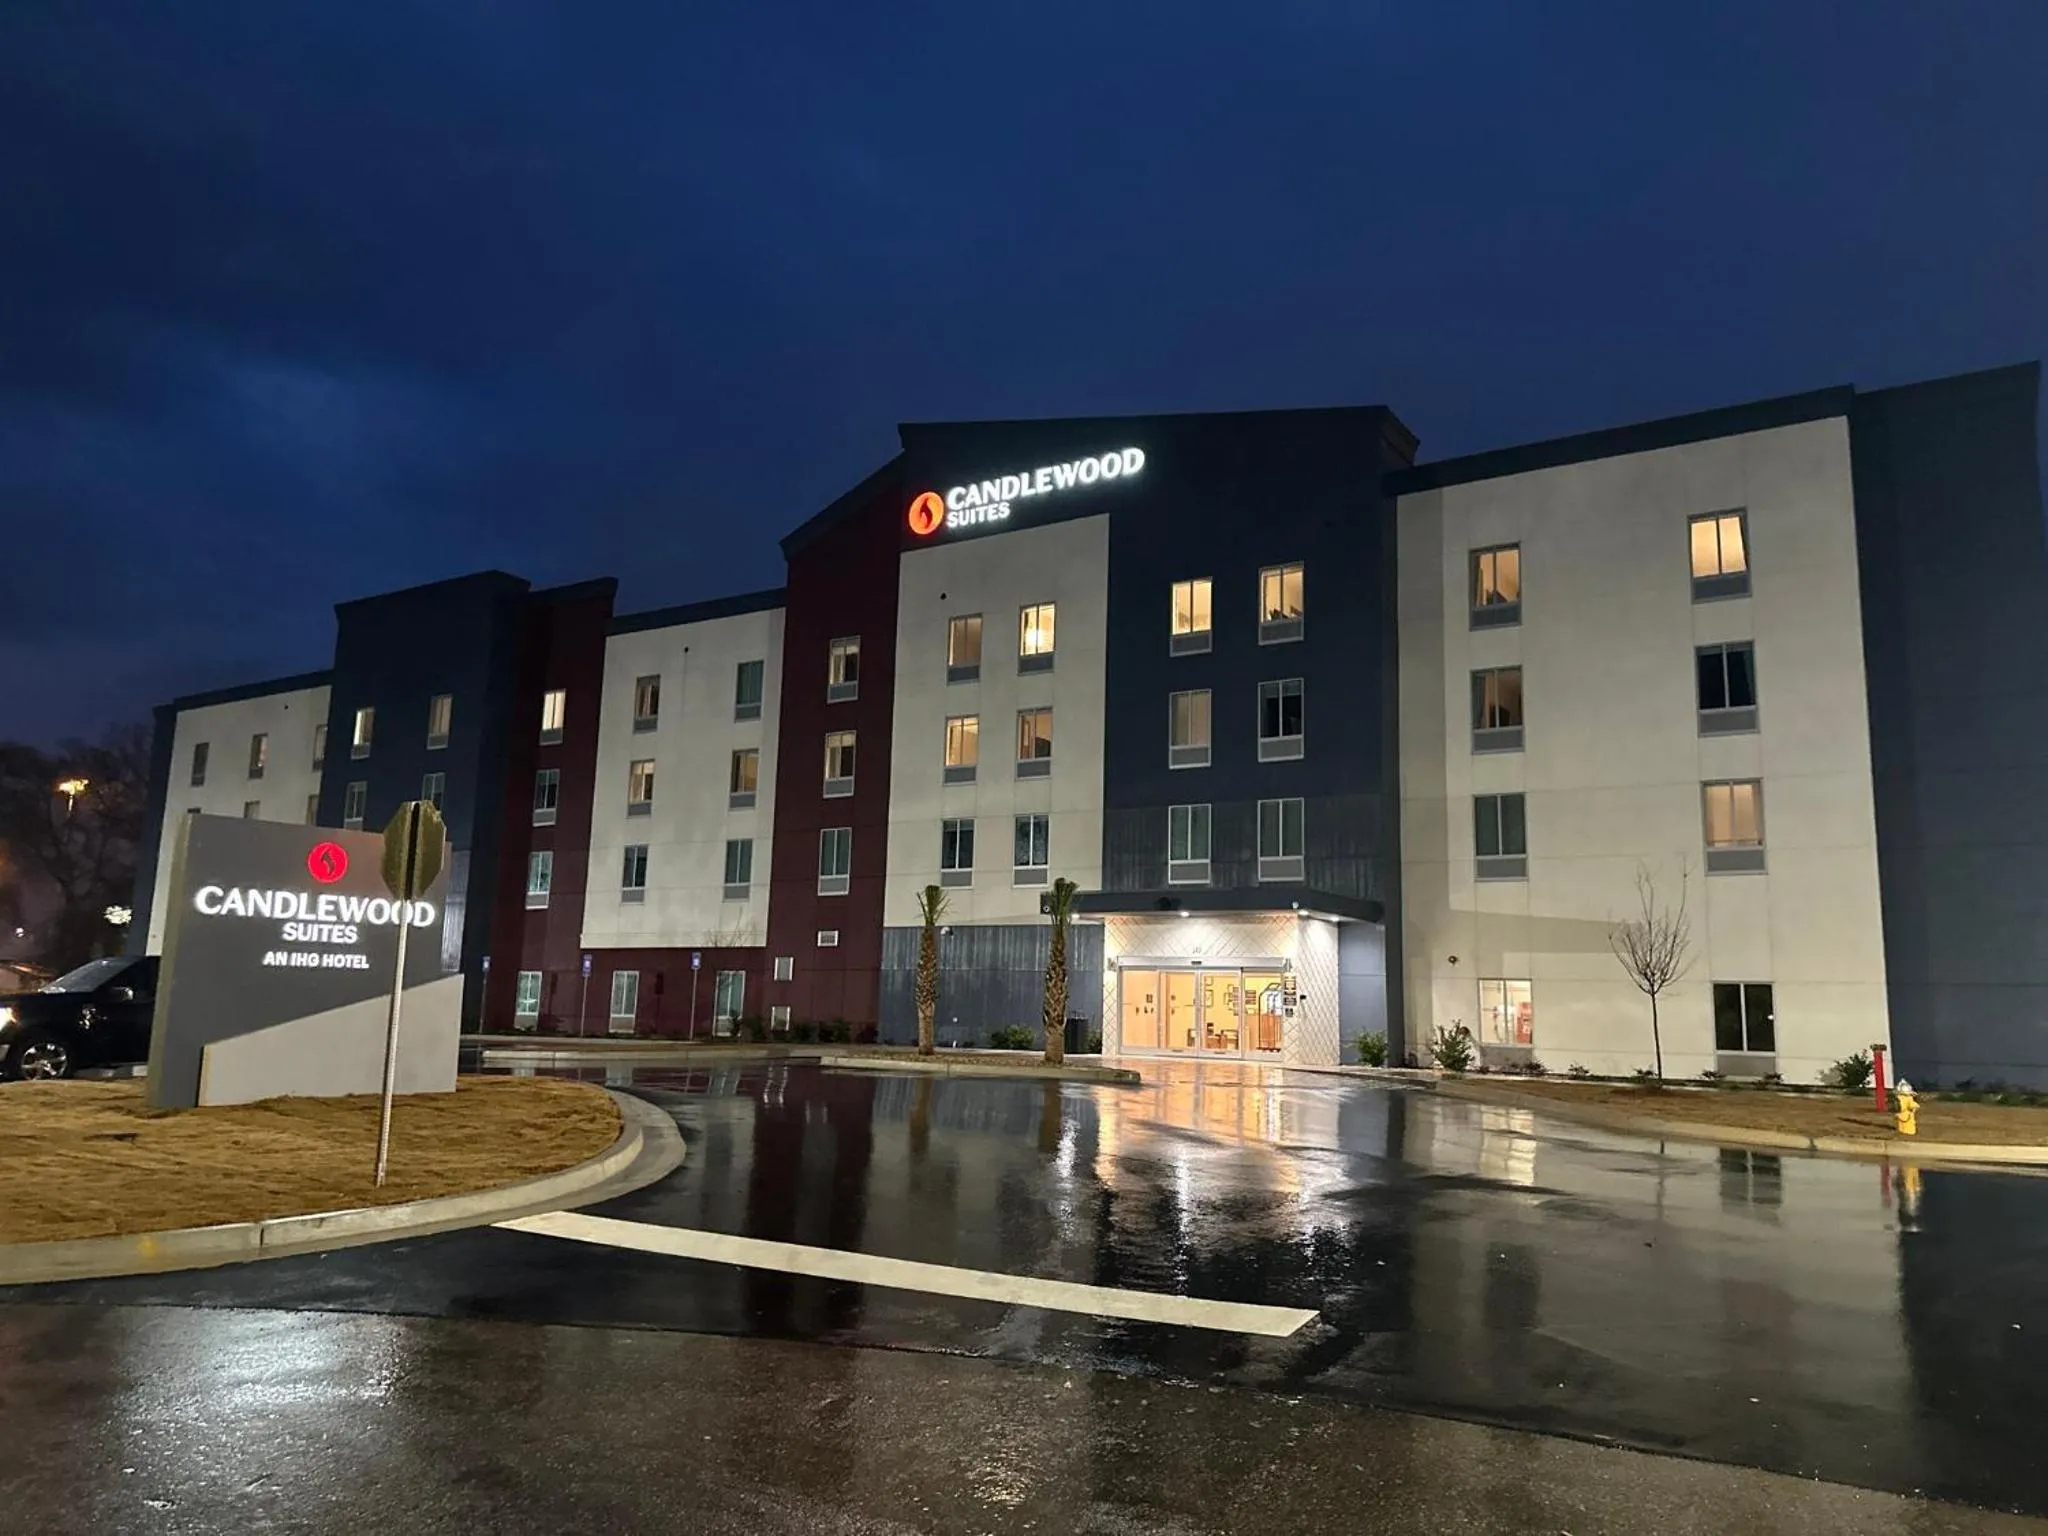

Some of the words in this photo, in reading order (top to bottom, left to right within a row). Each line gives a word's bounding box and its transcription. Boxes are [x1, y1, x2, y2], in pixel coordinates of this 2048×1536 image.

[947, 447, 1145, 510] CANDLEWOOD
[947, 502, 1010, 529] SUITES
[194, 886, 436, 927] CANDLEWOOD
[282, 922, 359, 943] SUITES
[263, 952, 287, 966] AN
[290, 953, 320, 968] IHG
[322, 955, 370, 969] HOTEL
